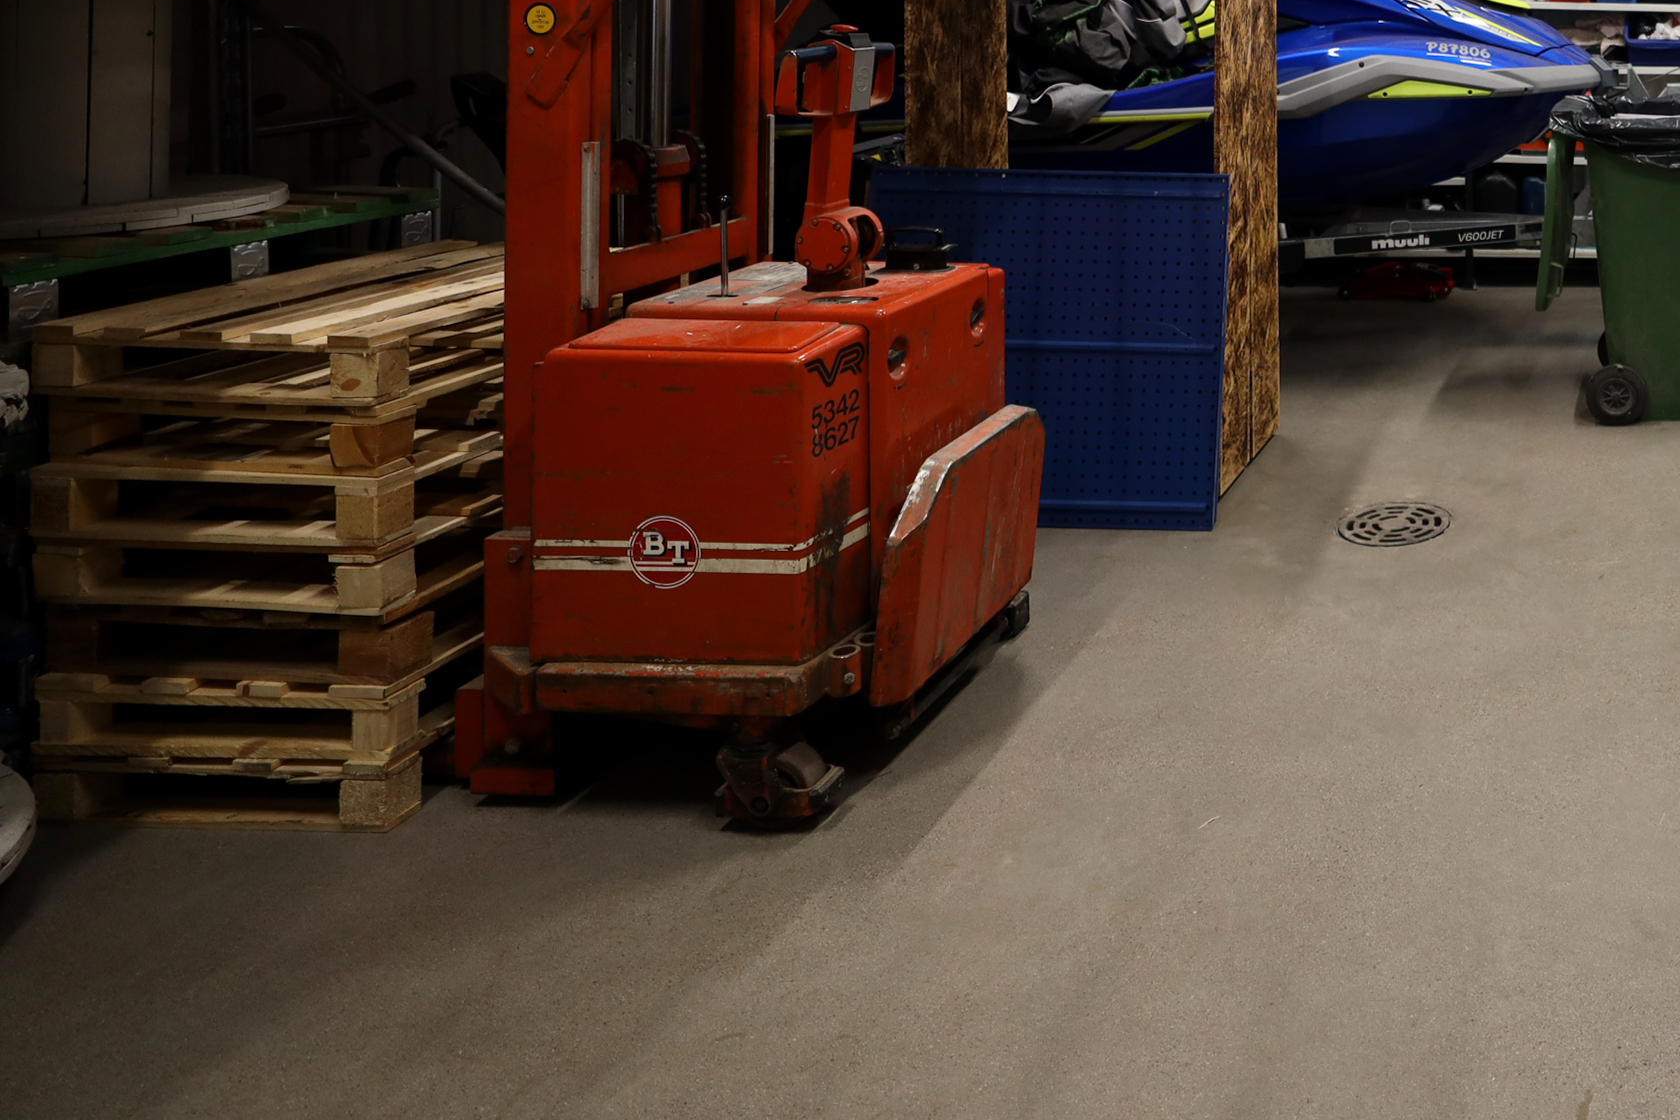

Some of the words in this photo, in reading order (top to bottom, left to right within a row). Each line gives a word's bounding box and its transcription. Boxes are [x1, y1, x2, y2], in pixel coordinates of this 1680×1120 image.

[1425, 41, 1492, 59] P87806
[1371, 233, 1431, 250] muuli
[1457, 230, 1505, 243] V600JET
[811, 388, 861, 430] 5342
[811, 415, 861, 458] 8627
[642, 531, 691, 565] BT
